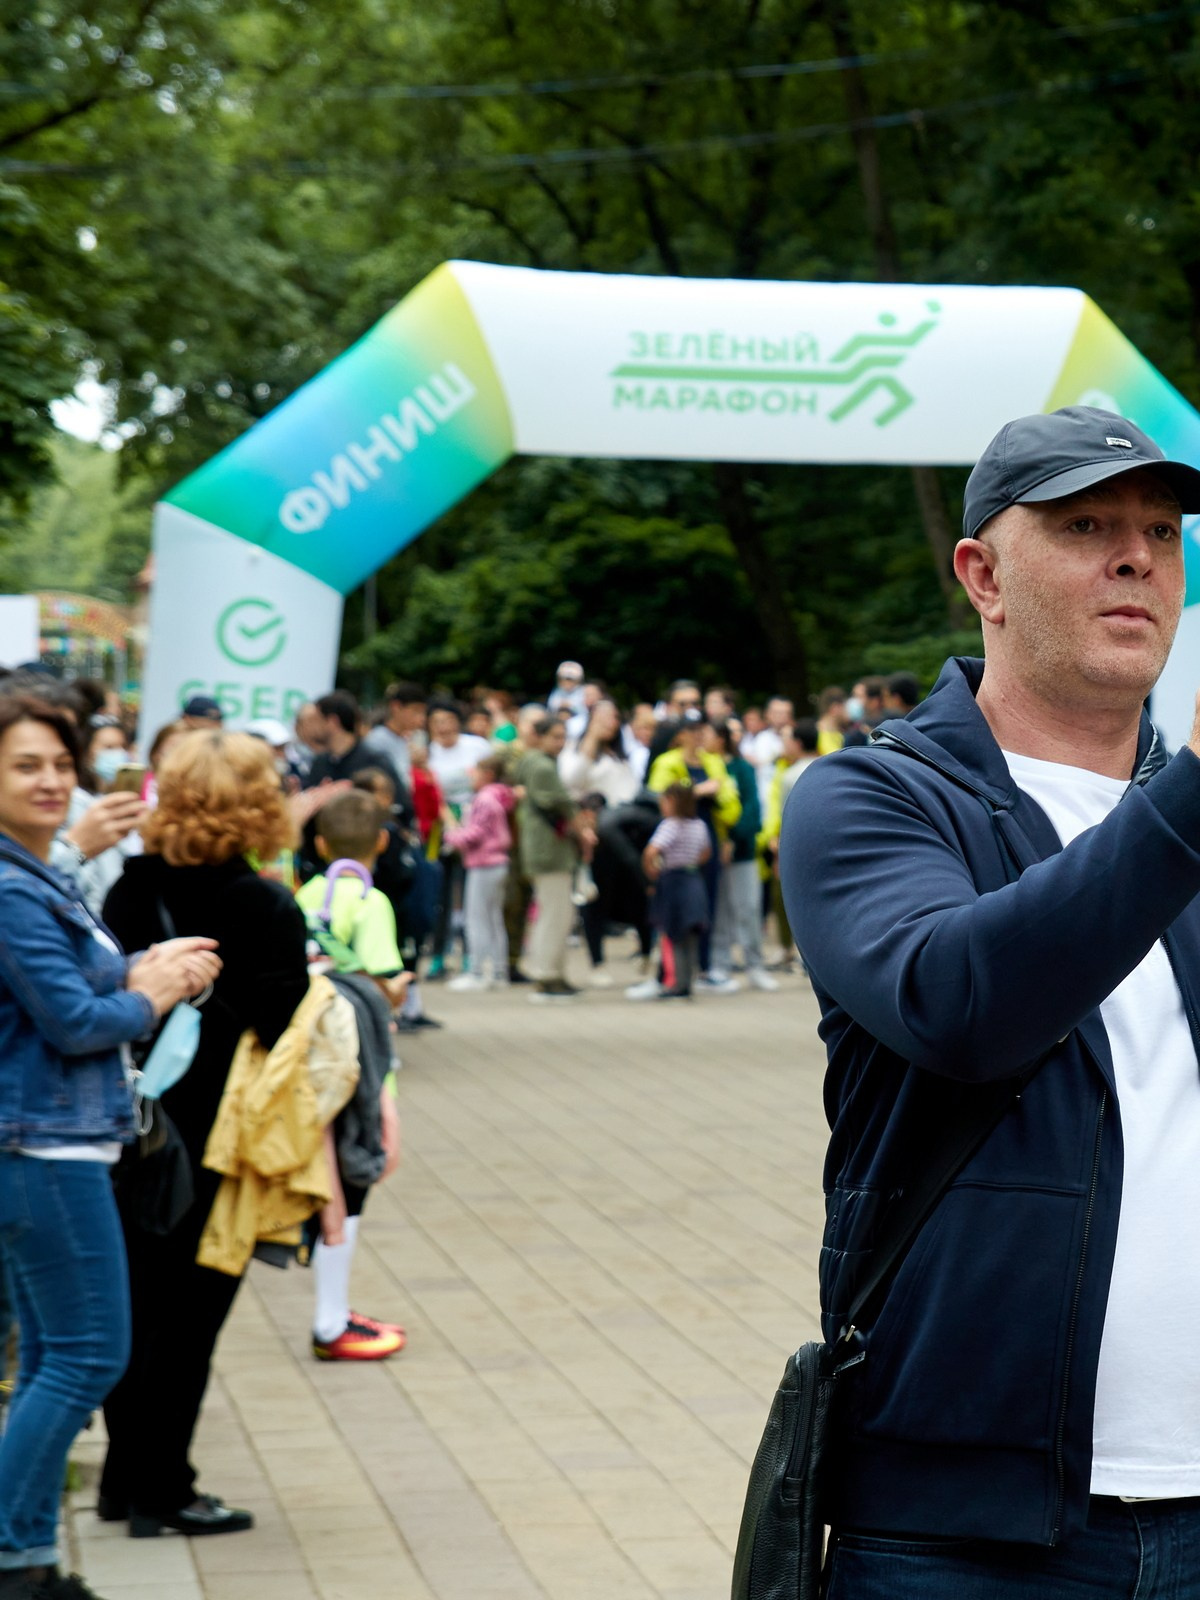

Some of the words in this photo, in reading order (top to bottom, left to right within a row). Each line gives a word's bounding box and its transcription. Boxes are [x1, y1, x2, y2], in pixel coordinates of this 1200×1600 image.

[629, 329, 820, 363] ЗЕЛЁНЫЙ
[612, 384, 818, 415] МАРАФОН
[279, 362, 477, 534] ФИНИШ
